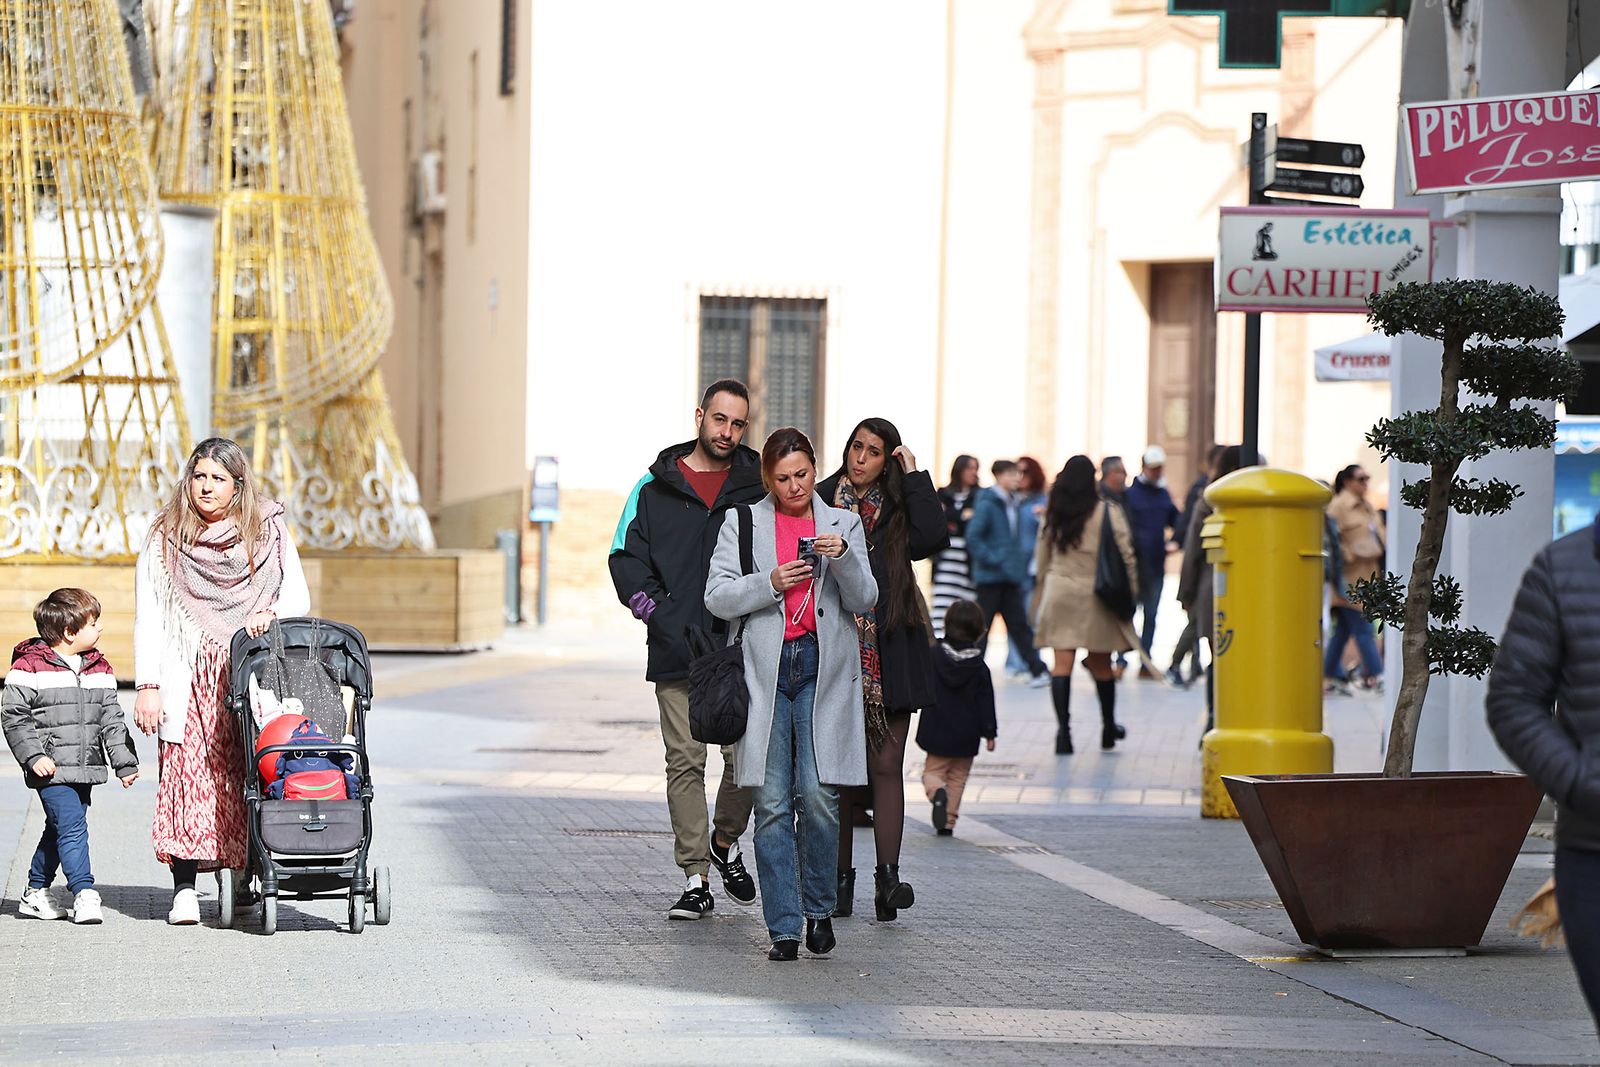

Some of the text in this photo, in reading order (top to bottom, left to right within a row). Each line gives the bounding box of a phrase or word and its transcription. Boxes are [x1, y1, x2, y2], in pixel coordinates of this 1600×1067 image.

[1416, 93, 1600, 157] PELUQUE
[1303, 220, 1411, 246] Estética
[1385, 245, 1423, 282] UNISEX
[1330, 351, 1391, 368] Cruzca
